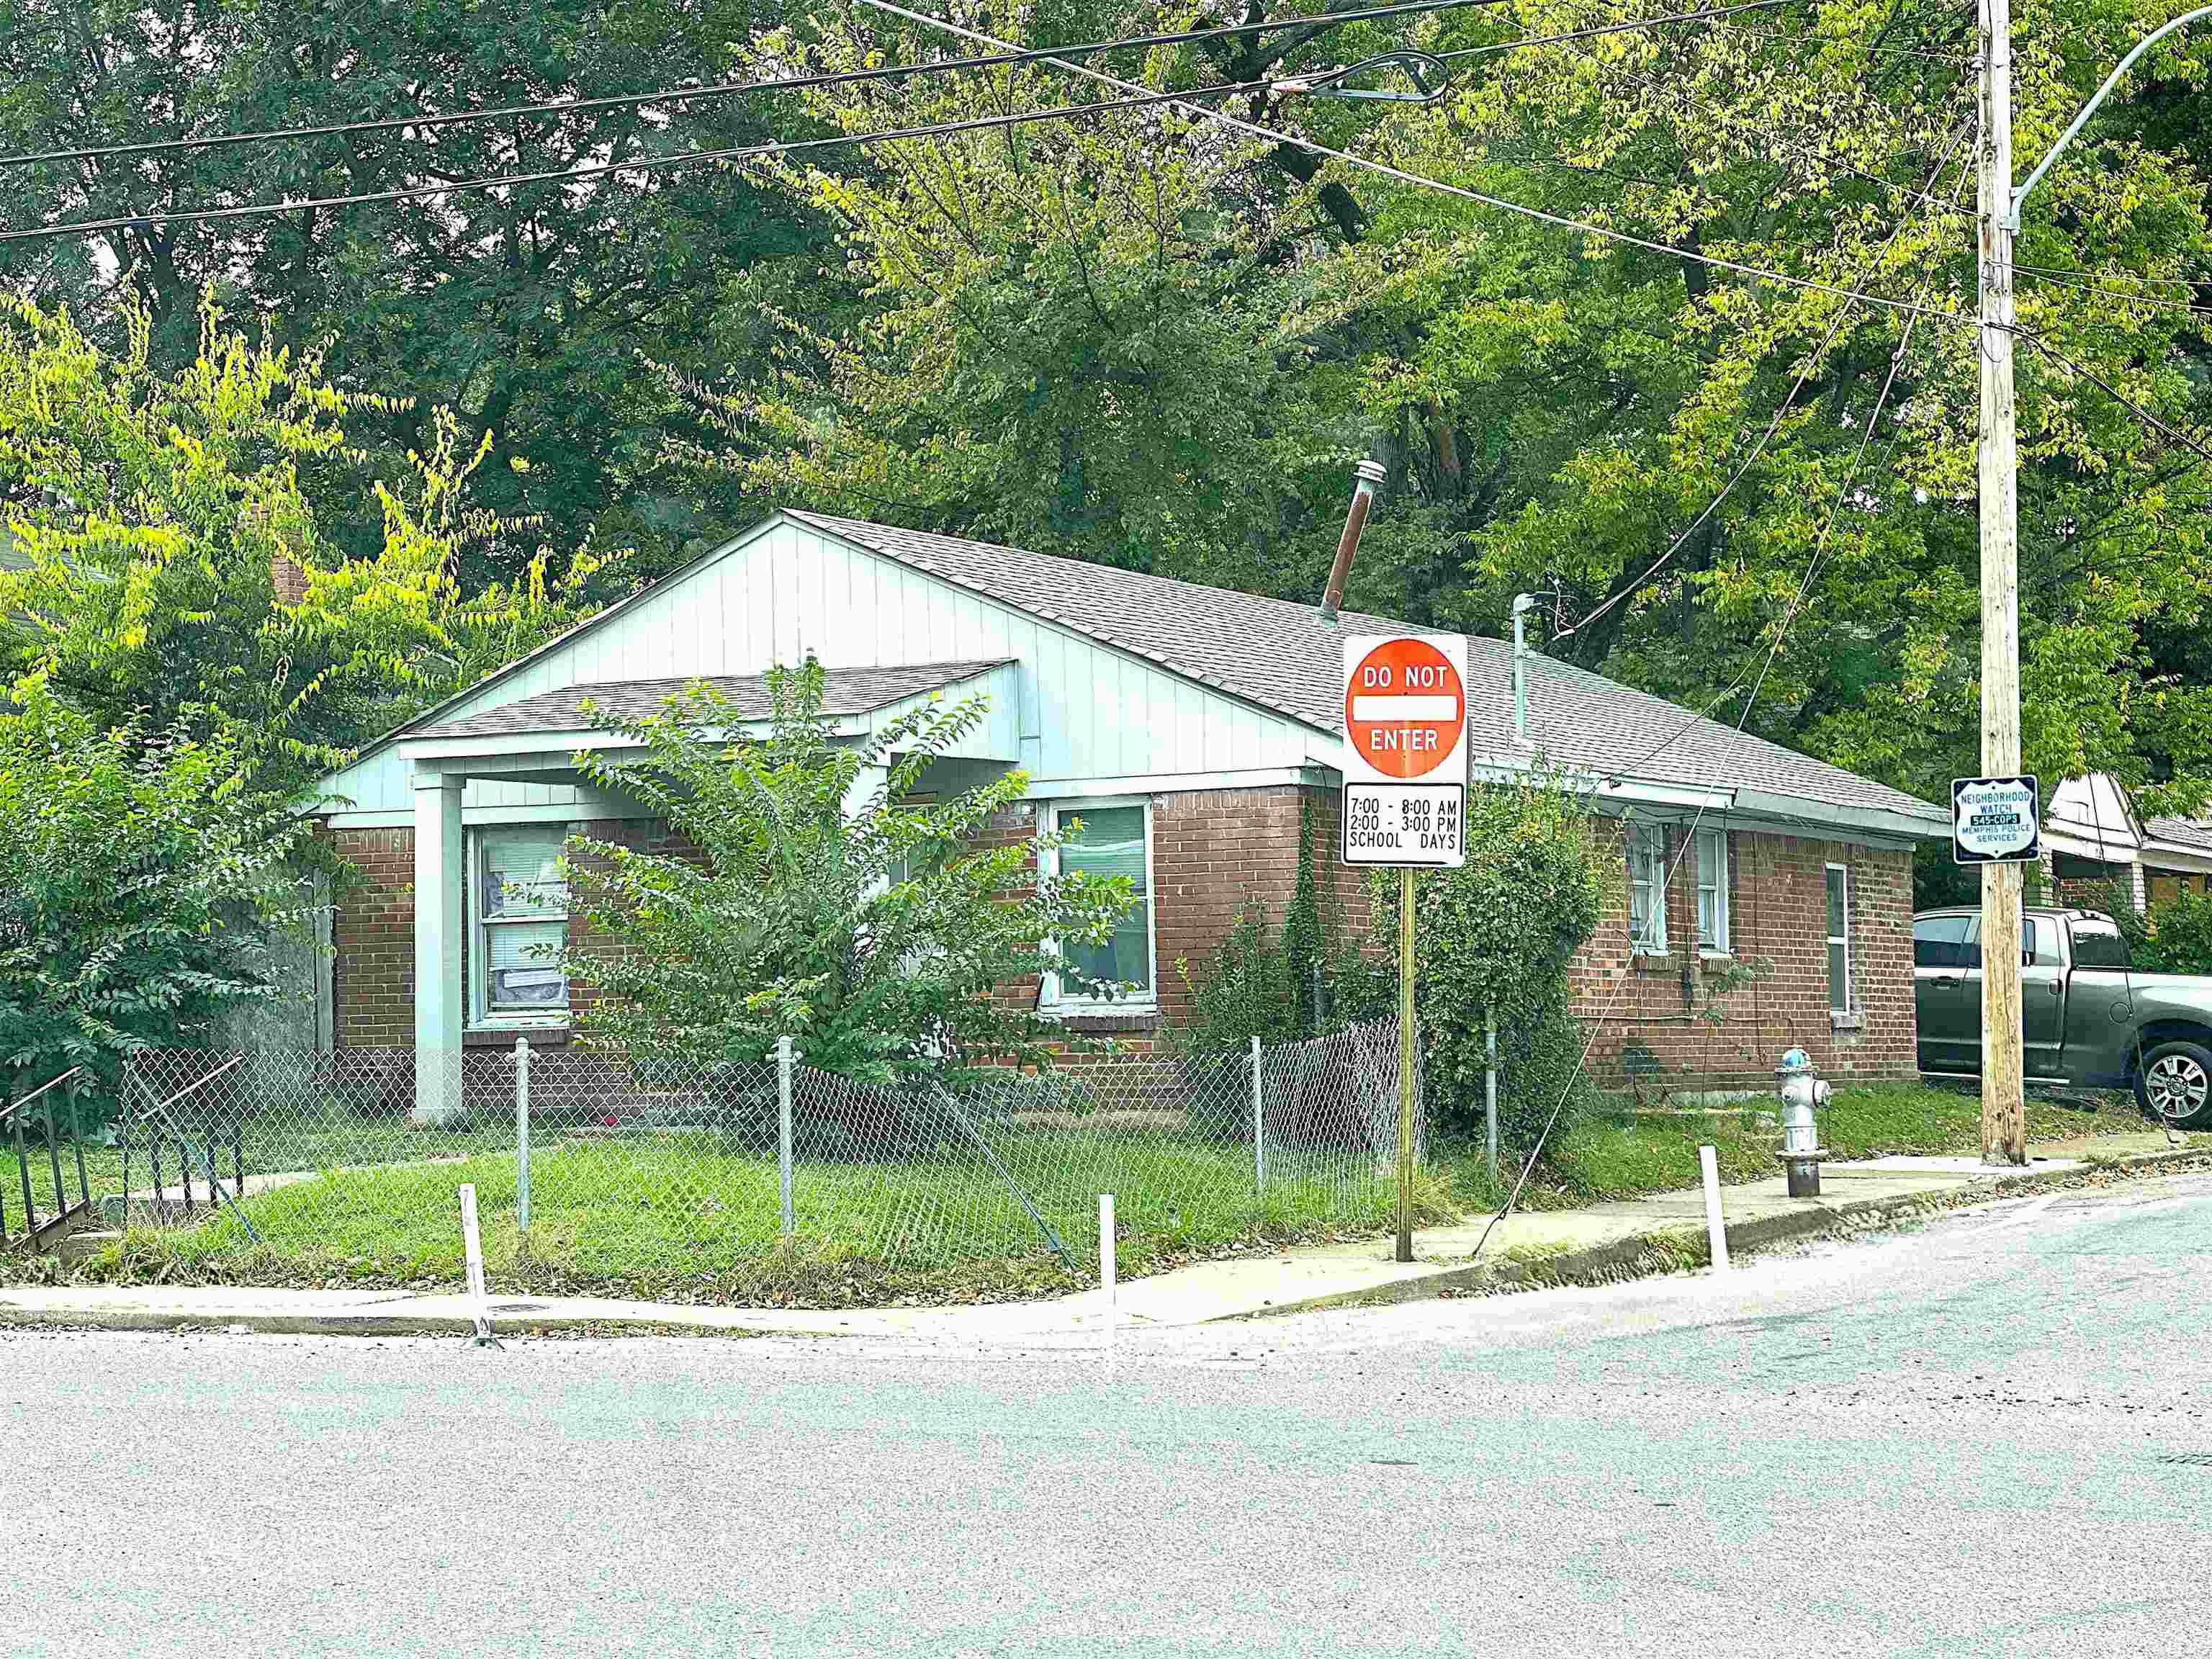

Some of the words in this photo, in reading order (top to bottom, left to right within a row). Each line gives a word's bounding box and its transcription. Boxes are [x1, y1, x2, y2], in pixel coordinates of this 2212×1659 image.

[1364, 666, 1392, 687] DO
[1405, 666, 1448, 687] NOT
[1370, 729, 1438, 750] ENTER
[1961, 791, 2030, 804] NEIGHBORHOOD
[1352, 798, 1380, 814] 7:00
[1402, 799, 1431, 814] 8:00
[1437, 801, 1457, 816] AM
[1981, 804, 2012, 814] WATCH
[1350, 815, 1380, 830] 2:00
[1401, 816, 1431, 832] 3:00
[1437, 817, 1456, 832] PM
[1962, 826, 1999, 835] MEMPHIS
[1349, 832, 1403, 848] SCHOOL
[1420, 835, 1455, 850] DAYS
